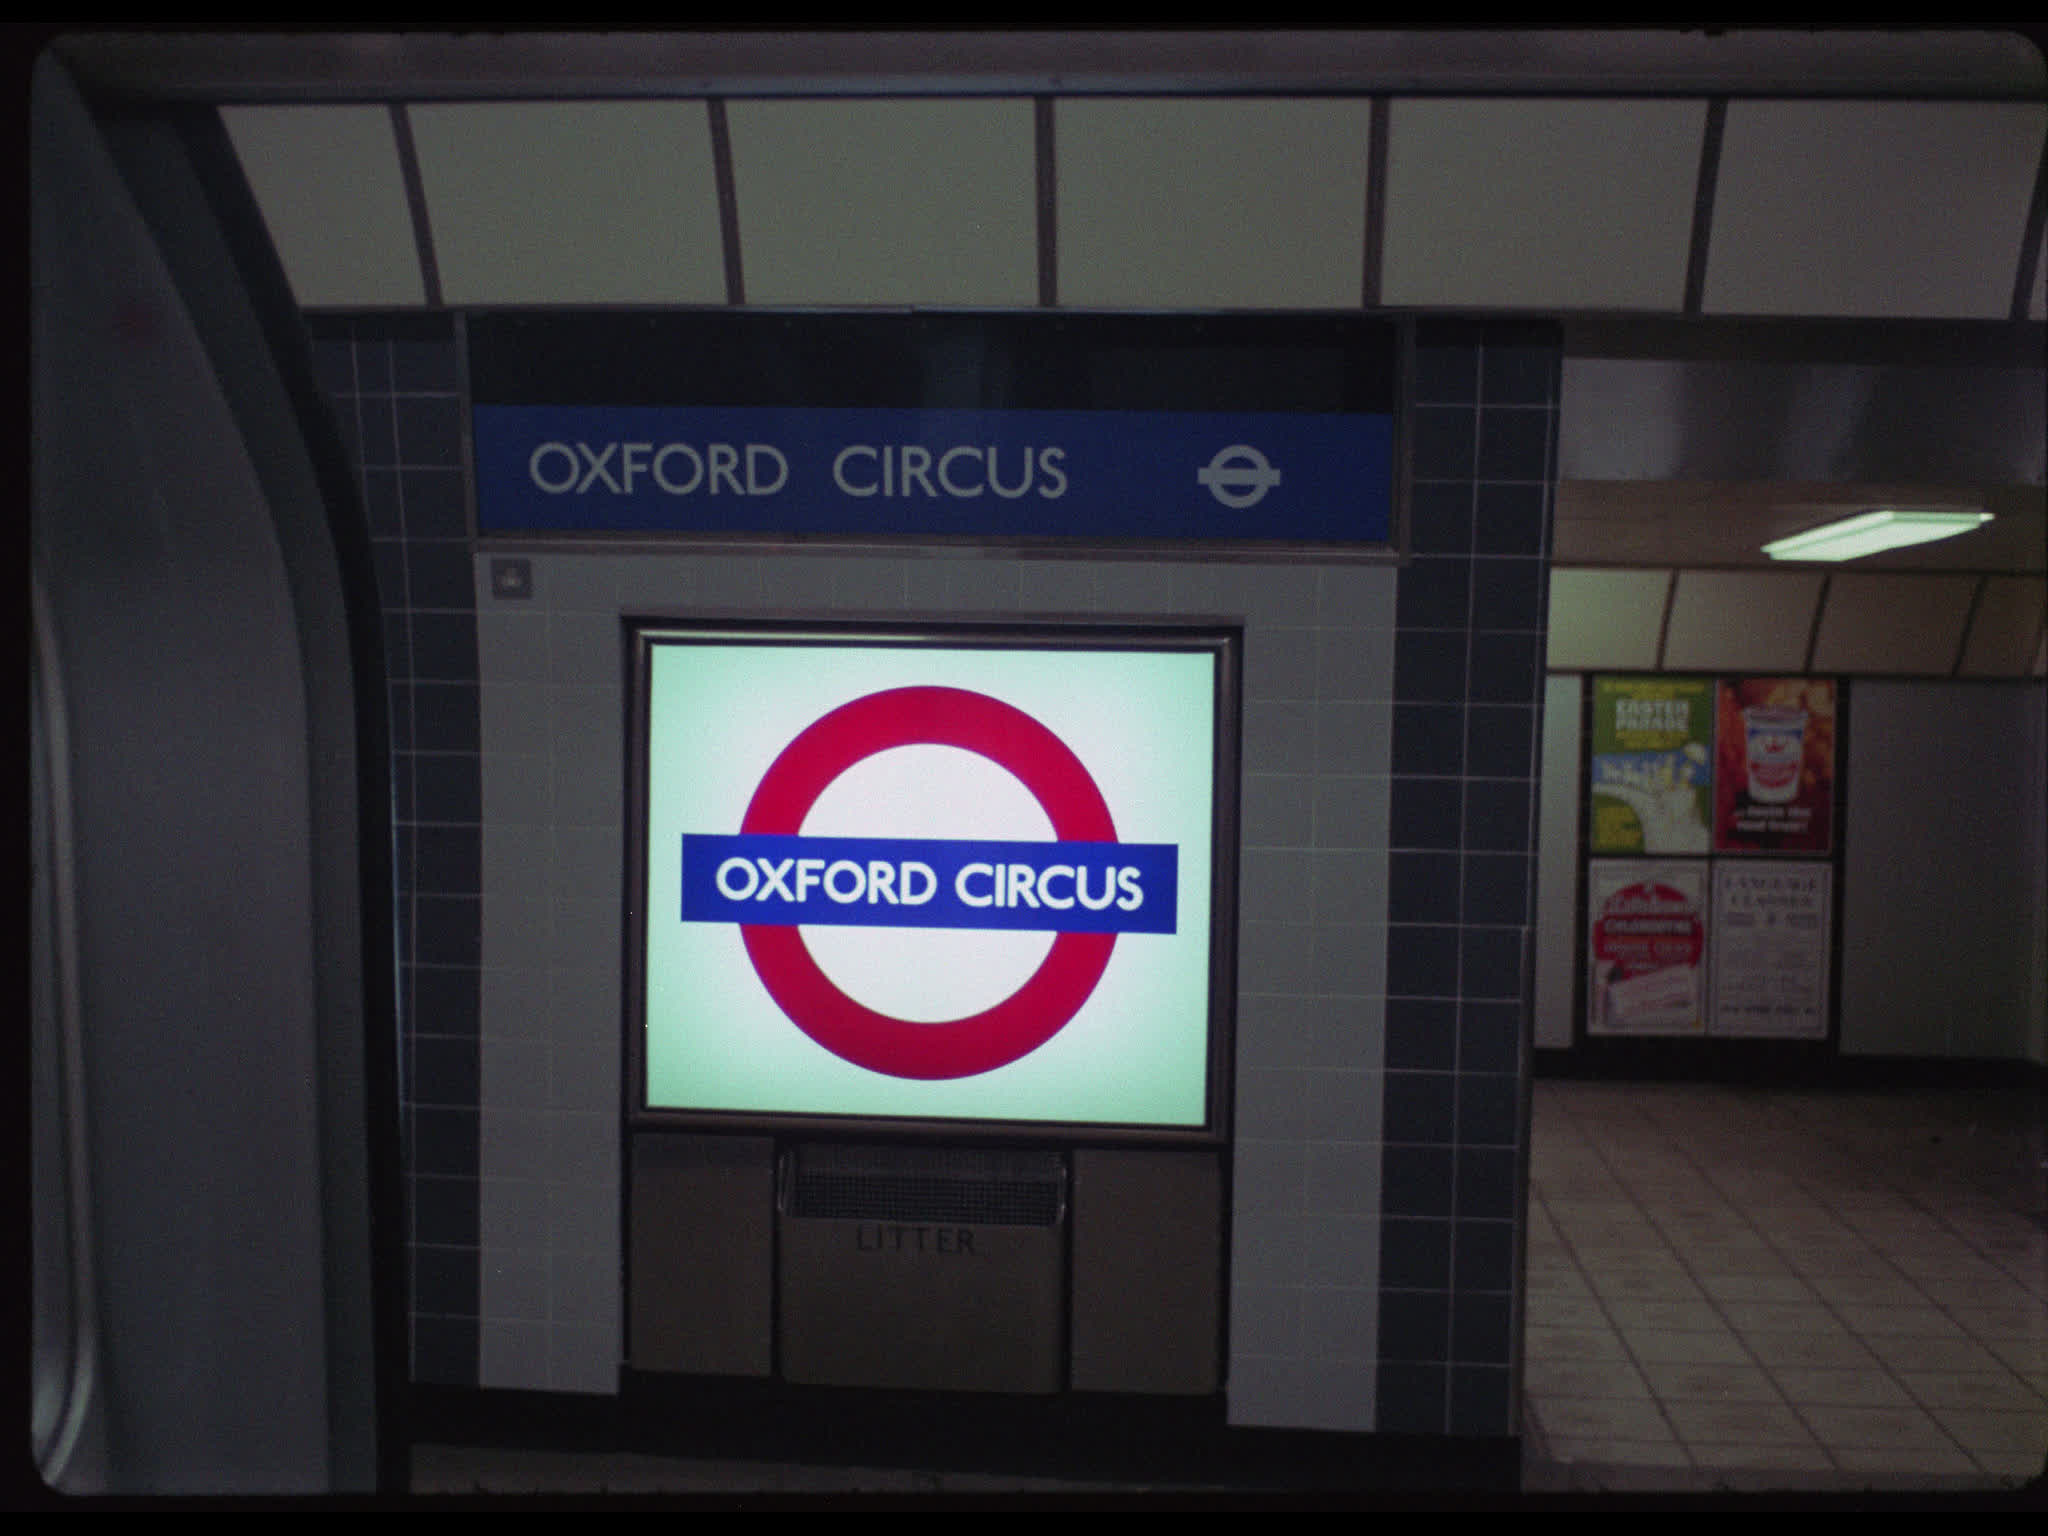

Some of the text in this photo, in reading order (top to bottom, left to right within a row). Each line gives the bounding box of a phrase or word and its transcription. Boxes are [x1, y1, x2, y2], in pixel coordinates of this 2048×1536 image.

[529, 442, 1068, 499] OXFORD CIRCUS
[715, 857, 1145, 911] OXFORD CIRCUS
[857, 1224, 976, 1254] LITTER
